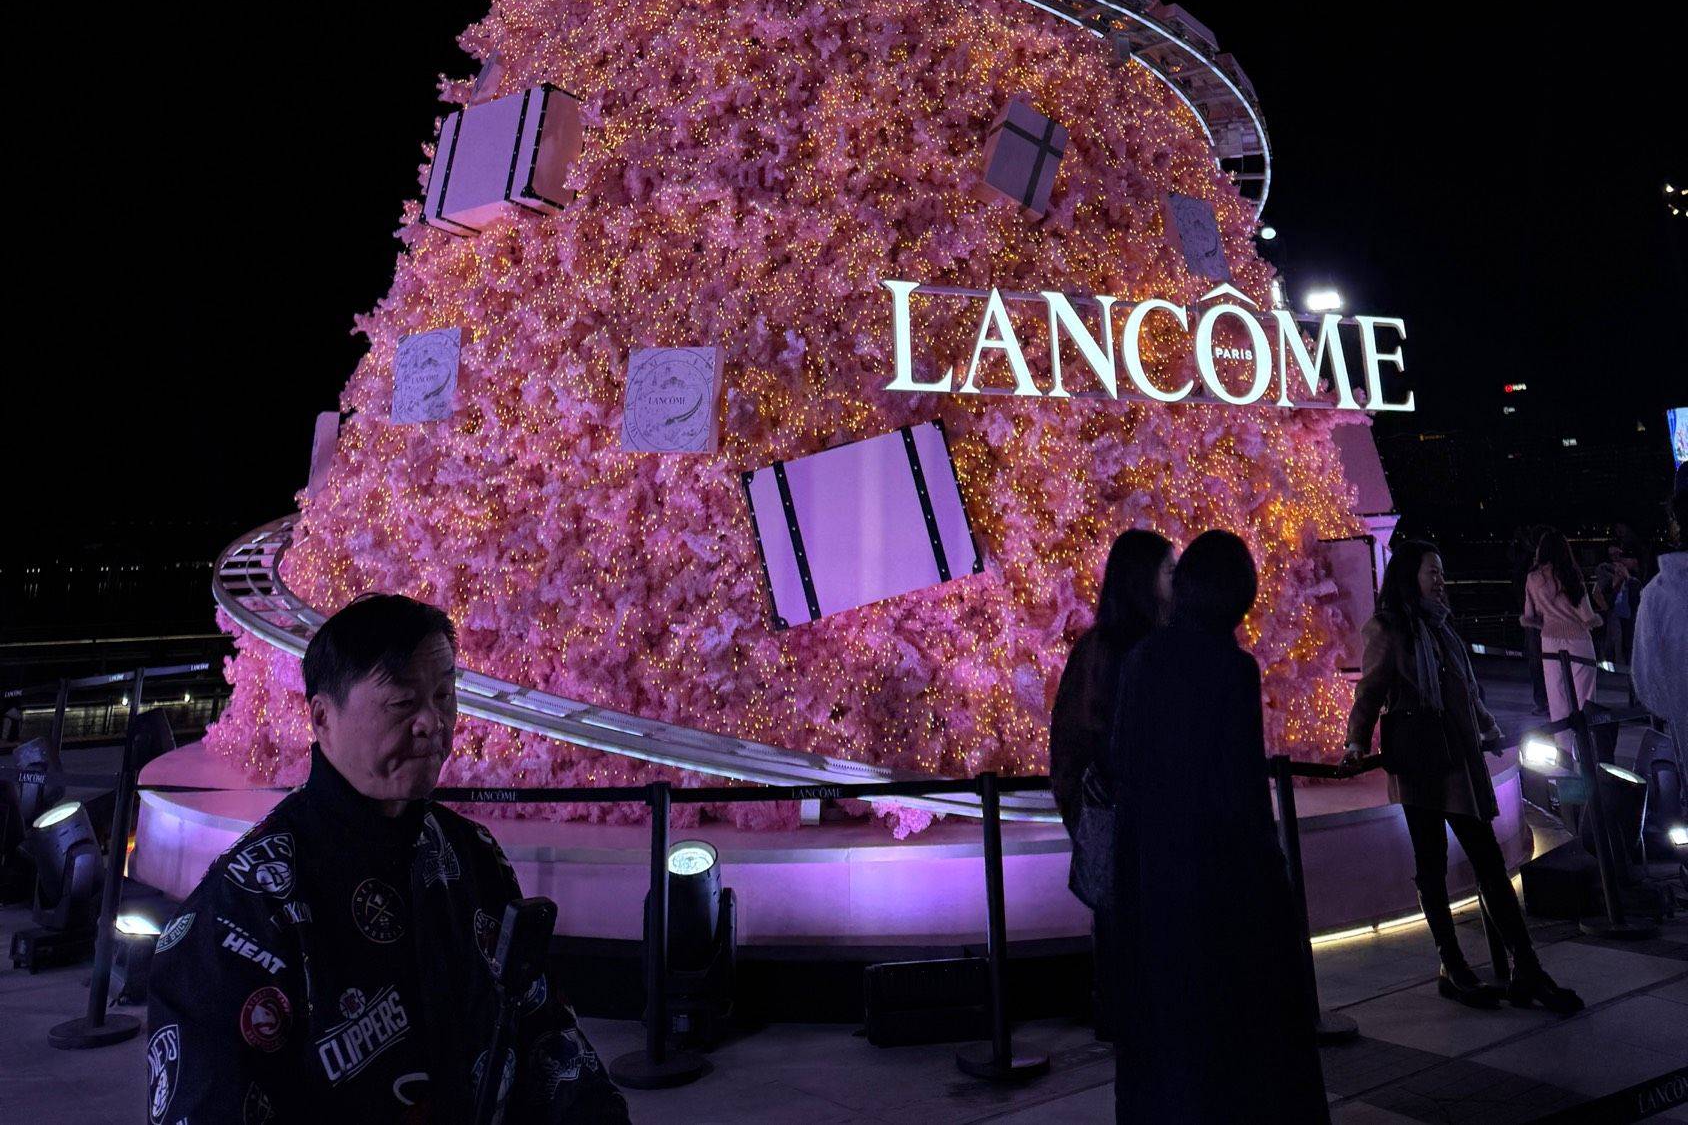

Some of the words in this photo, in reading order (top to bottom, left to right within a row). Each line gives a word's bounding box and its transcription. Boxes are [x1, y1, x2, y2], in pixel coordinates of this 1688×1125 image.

[884, 280, 1416, 413] LANCÔME
[1215, 347, 1253, 361] PARIS
[227, 835, 294, 884] NETS
[221, 932, 288, 976] HEAT
[318, 990, 408, 1081] CLIPPERS
